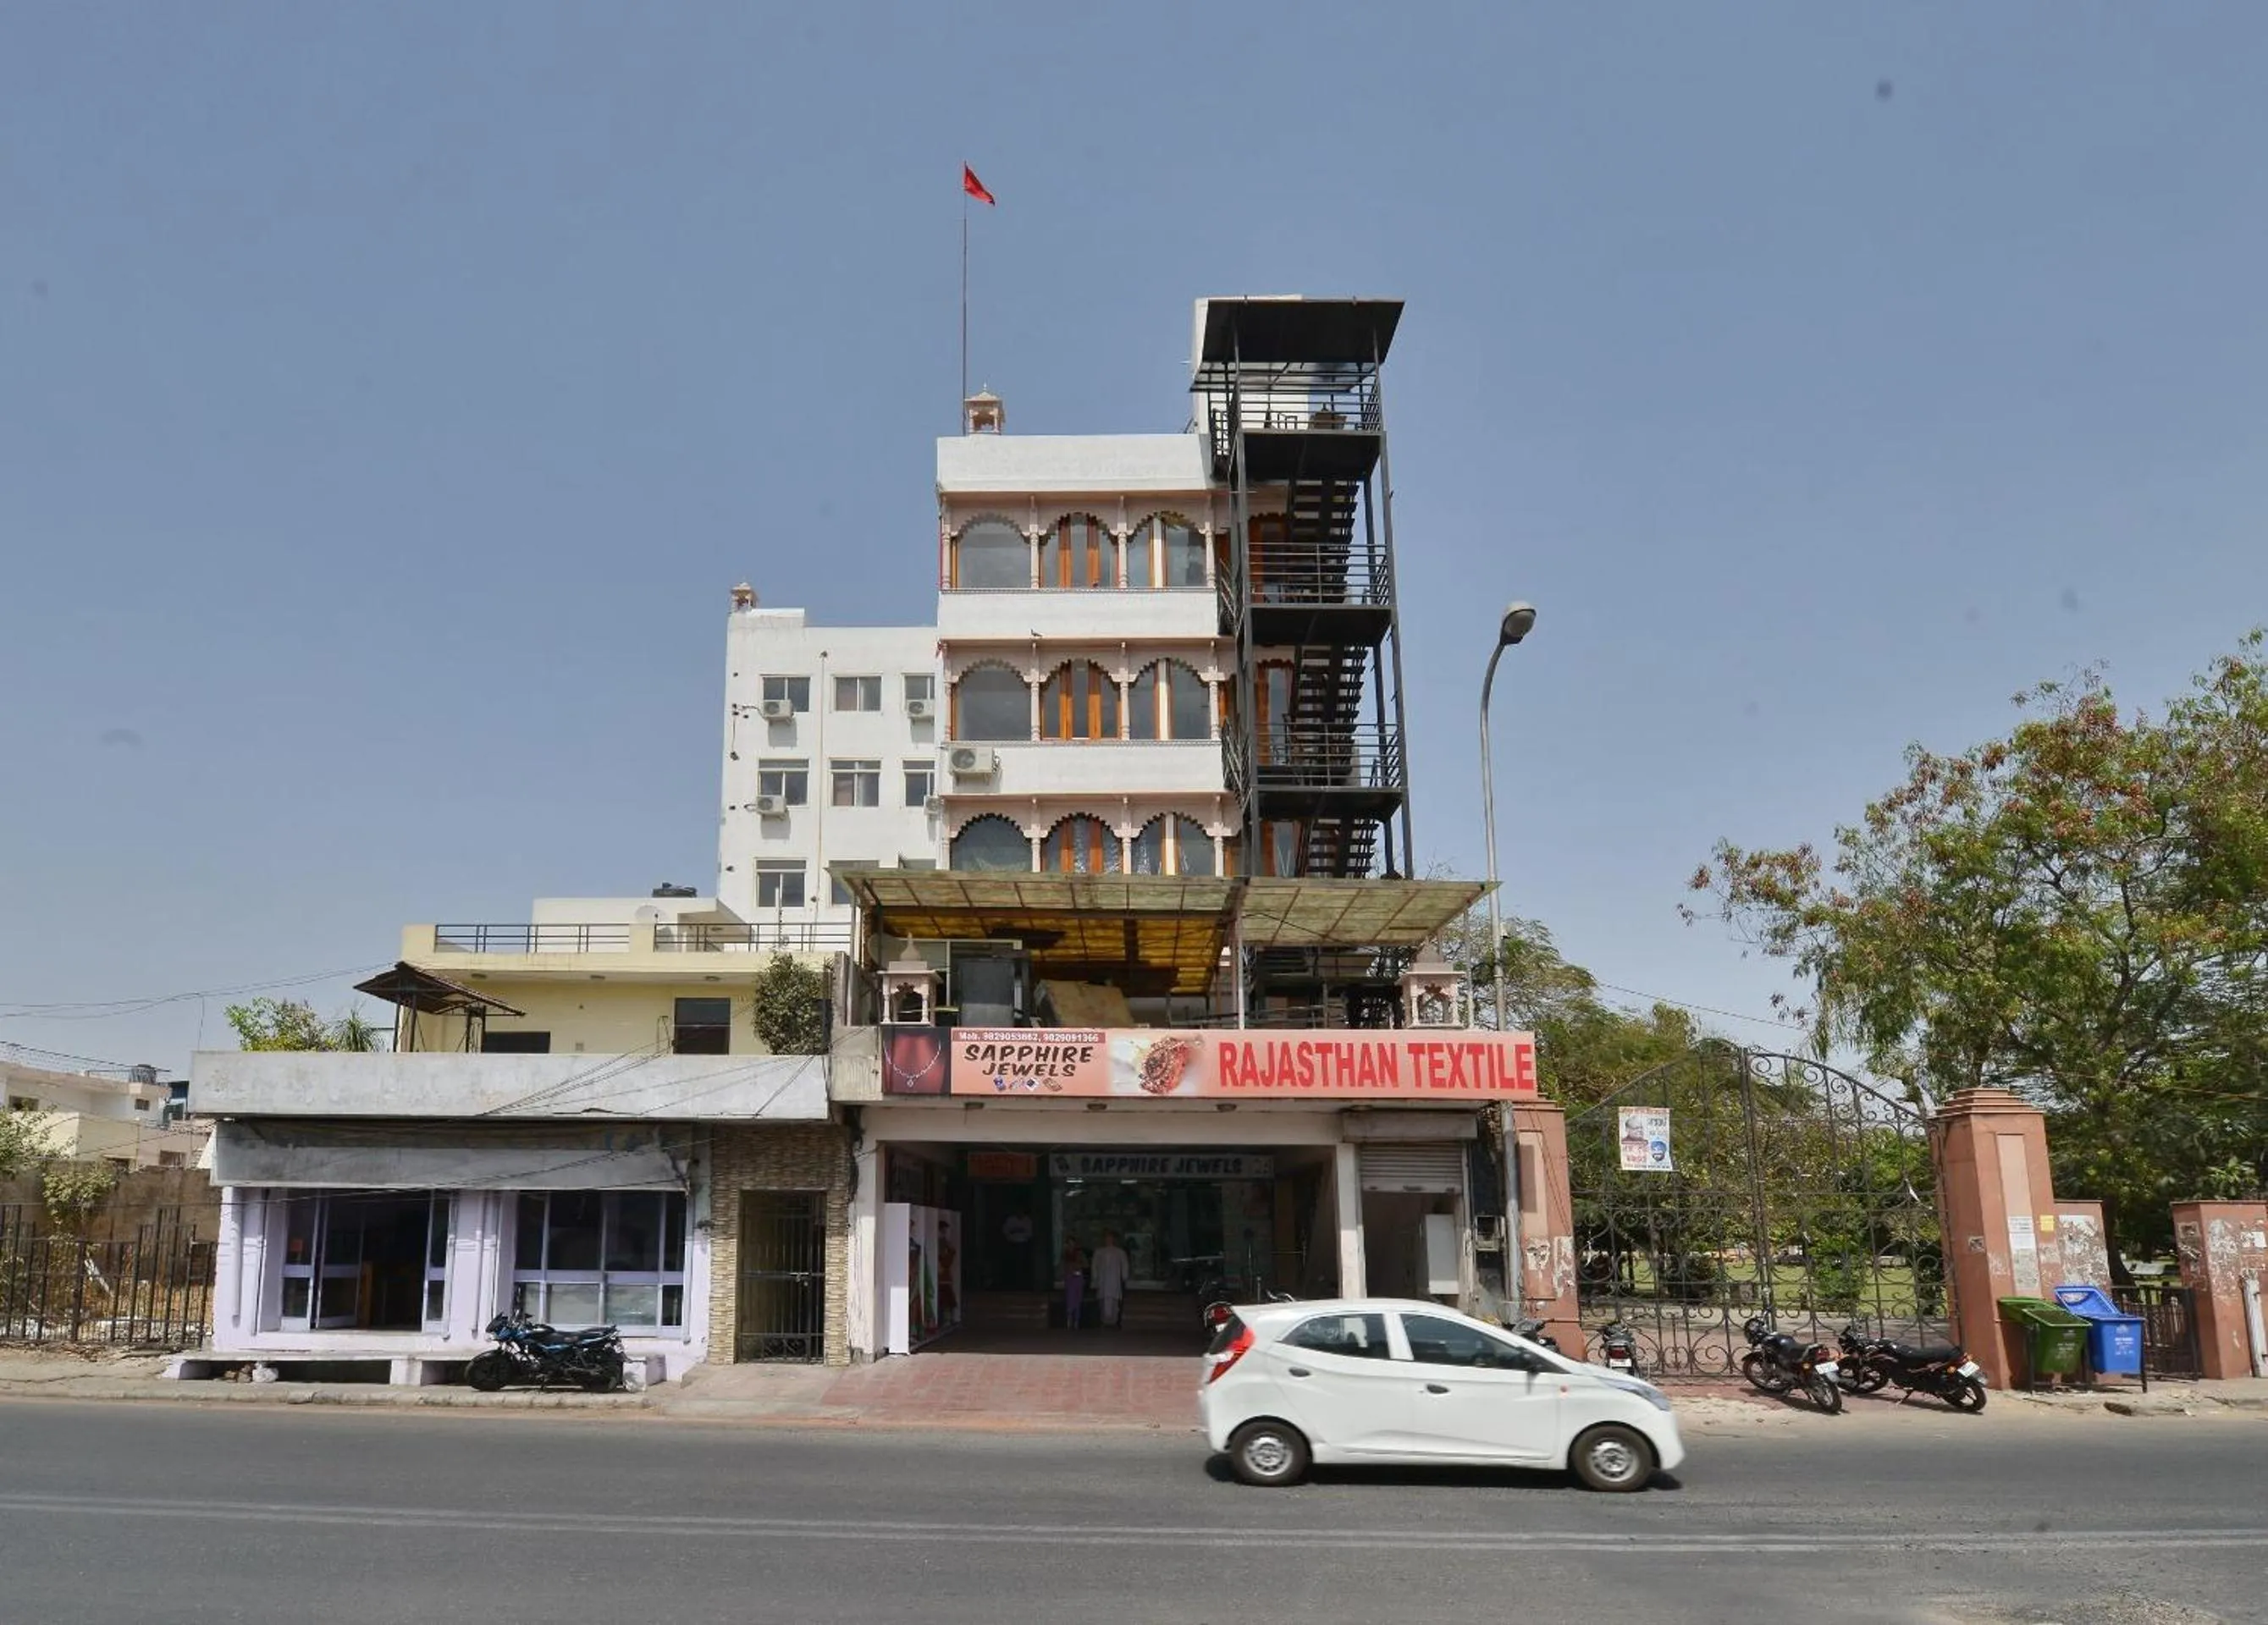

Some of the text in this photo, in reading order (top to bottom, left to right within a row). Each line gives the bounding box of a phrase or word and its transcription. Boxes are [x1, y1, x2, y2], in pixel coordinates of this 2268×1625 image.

[963, 1044, 1094, 1063] SAPPHIRE
[982, 1061, 1076, 1077] JEWELS
[1218, 1041, 1534, 1090] RAJASTHAN TEXTILE
[1080, 1157, 1170, 1175] SAPPHIRE
[1174, 1157, 1243, 1175] JEWELS
